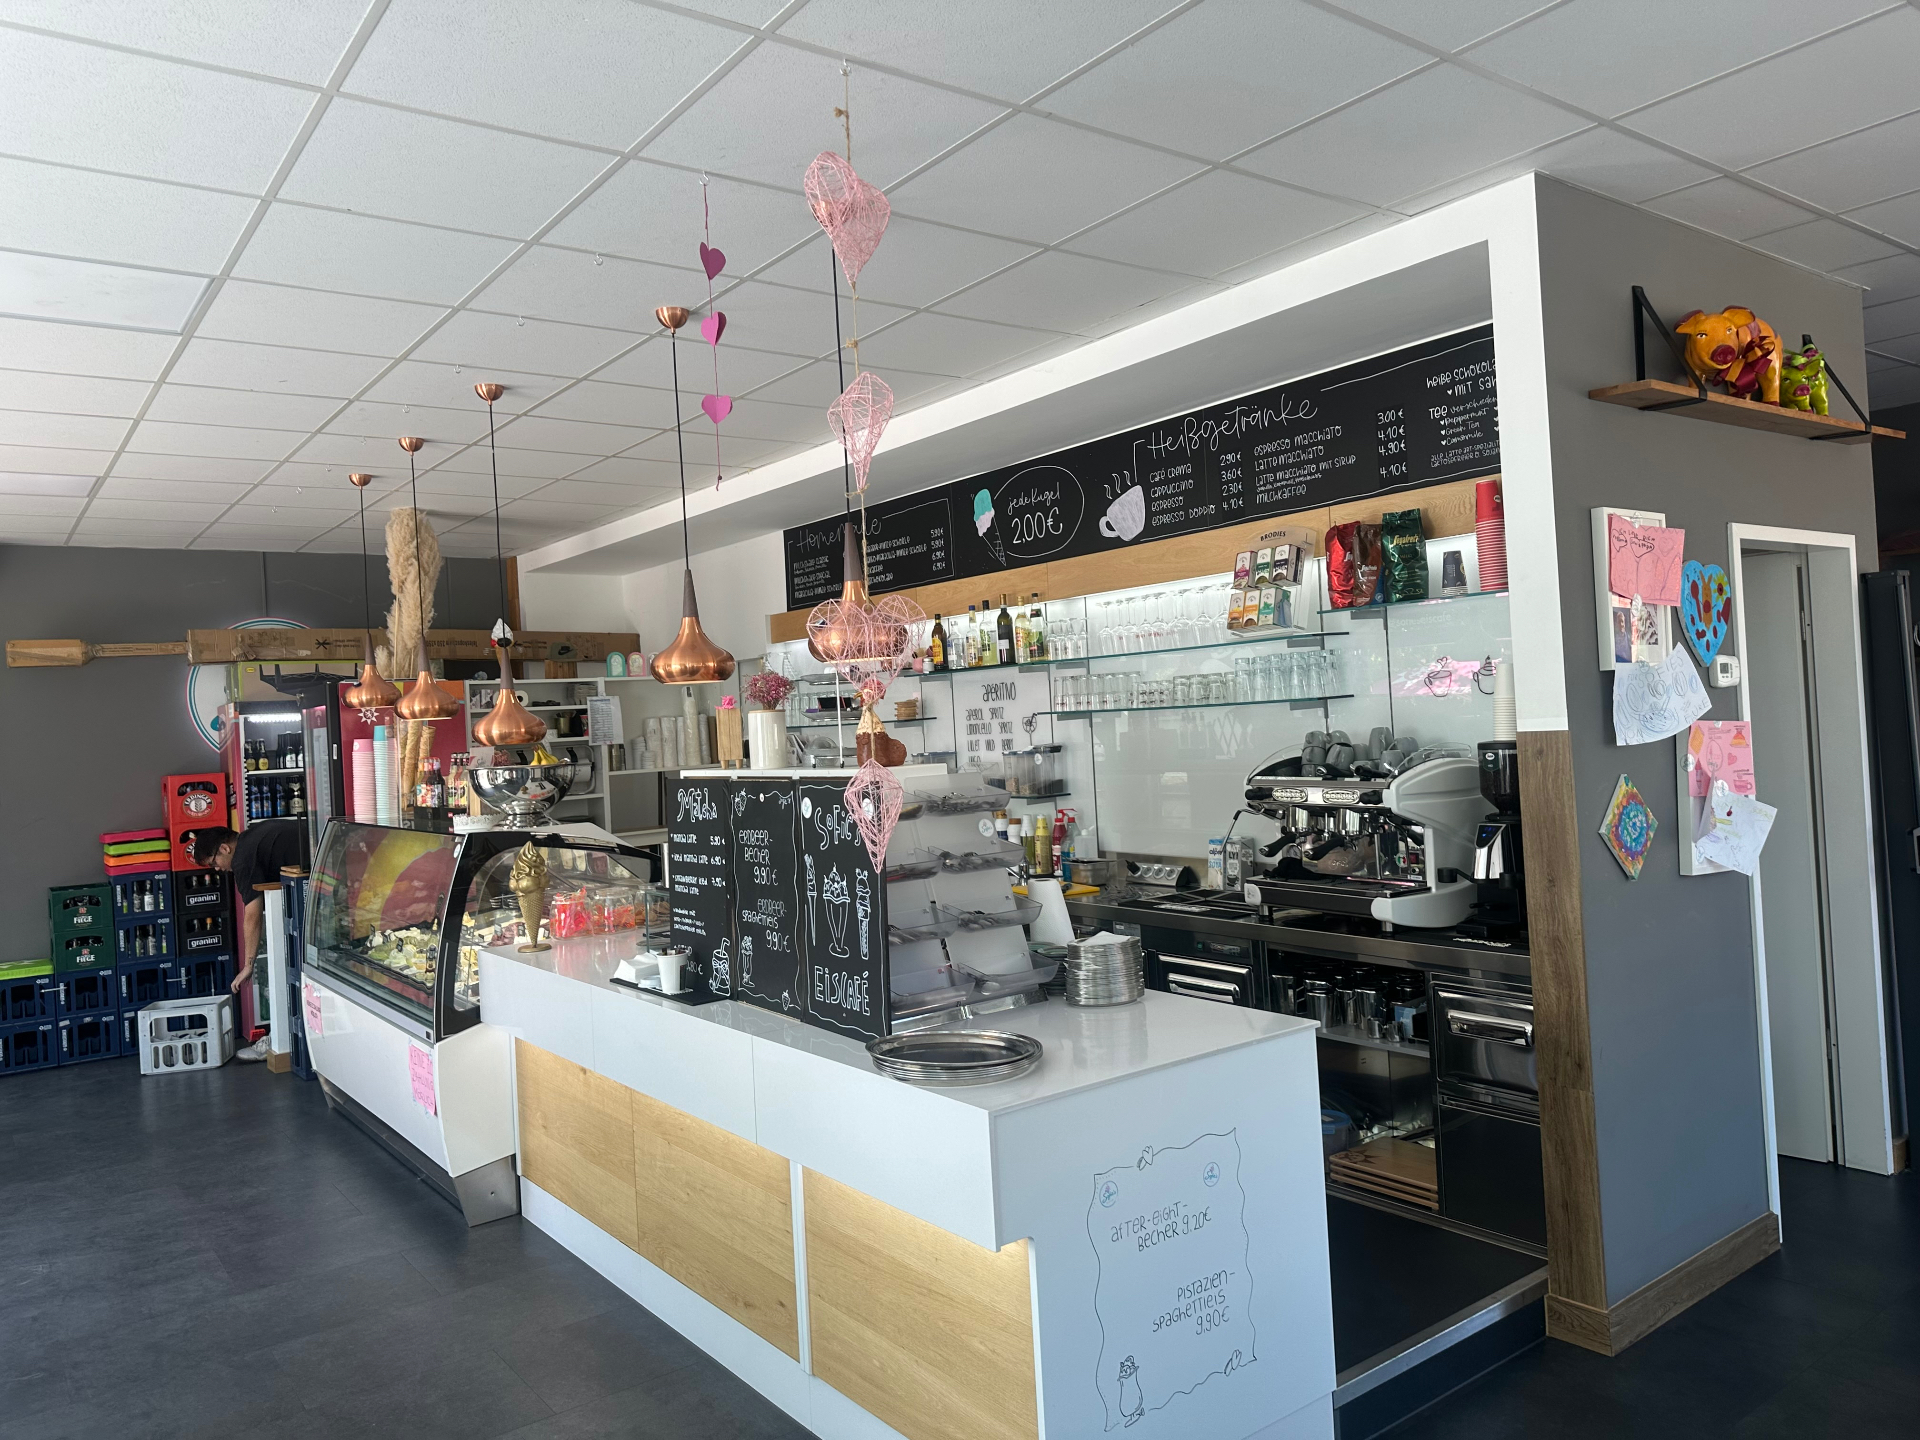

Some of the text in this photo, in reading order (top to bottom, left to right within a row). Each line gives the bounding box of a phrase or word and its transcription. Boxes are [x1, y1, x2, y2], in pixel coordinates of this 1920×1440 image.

[1147, 393, 1318, 459] Heißgetränke
[1011, 507, 1063, 544] 2,00€
[1260, 530, 1286, 542] BRODIES
[189, 894, 217, 905] granini
[191, 937, 219, 948] granini
